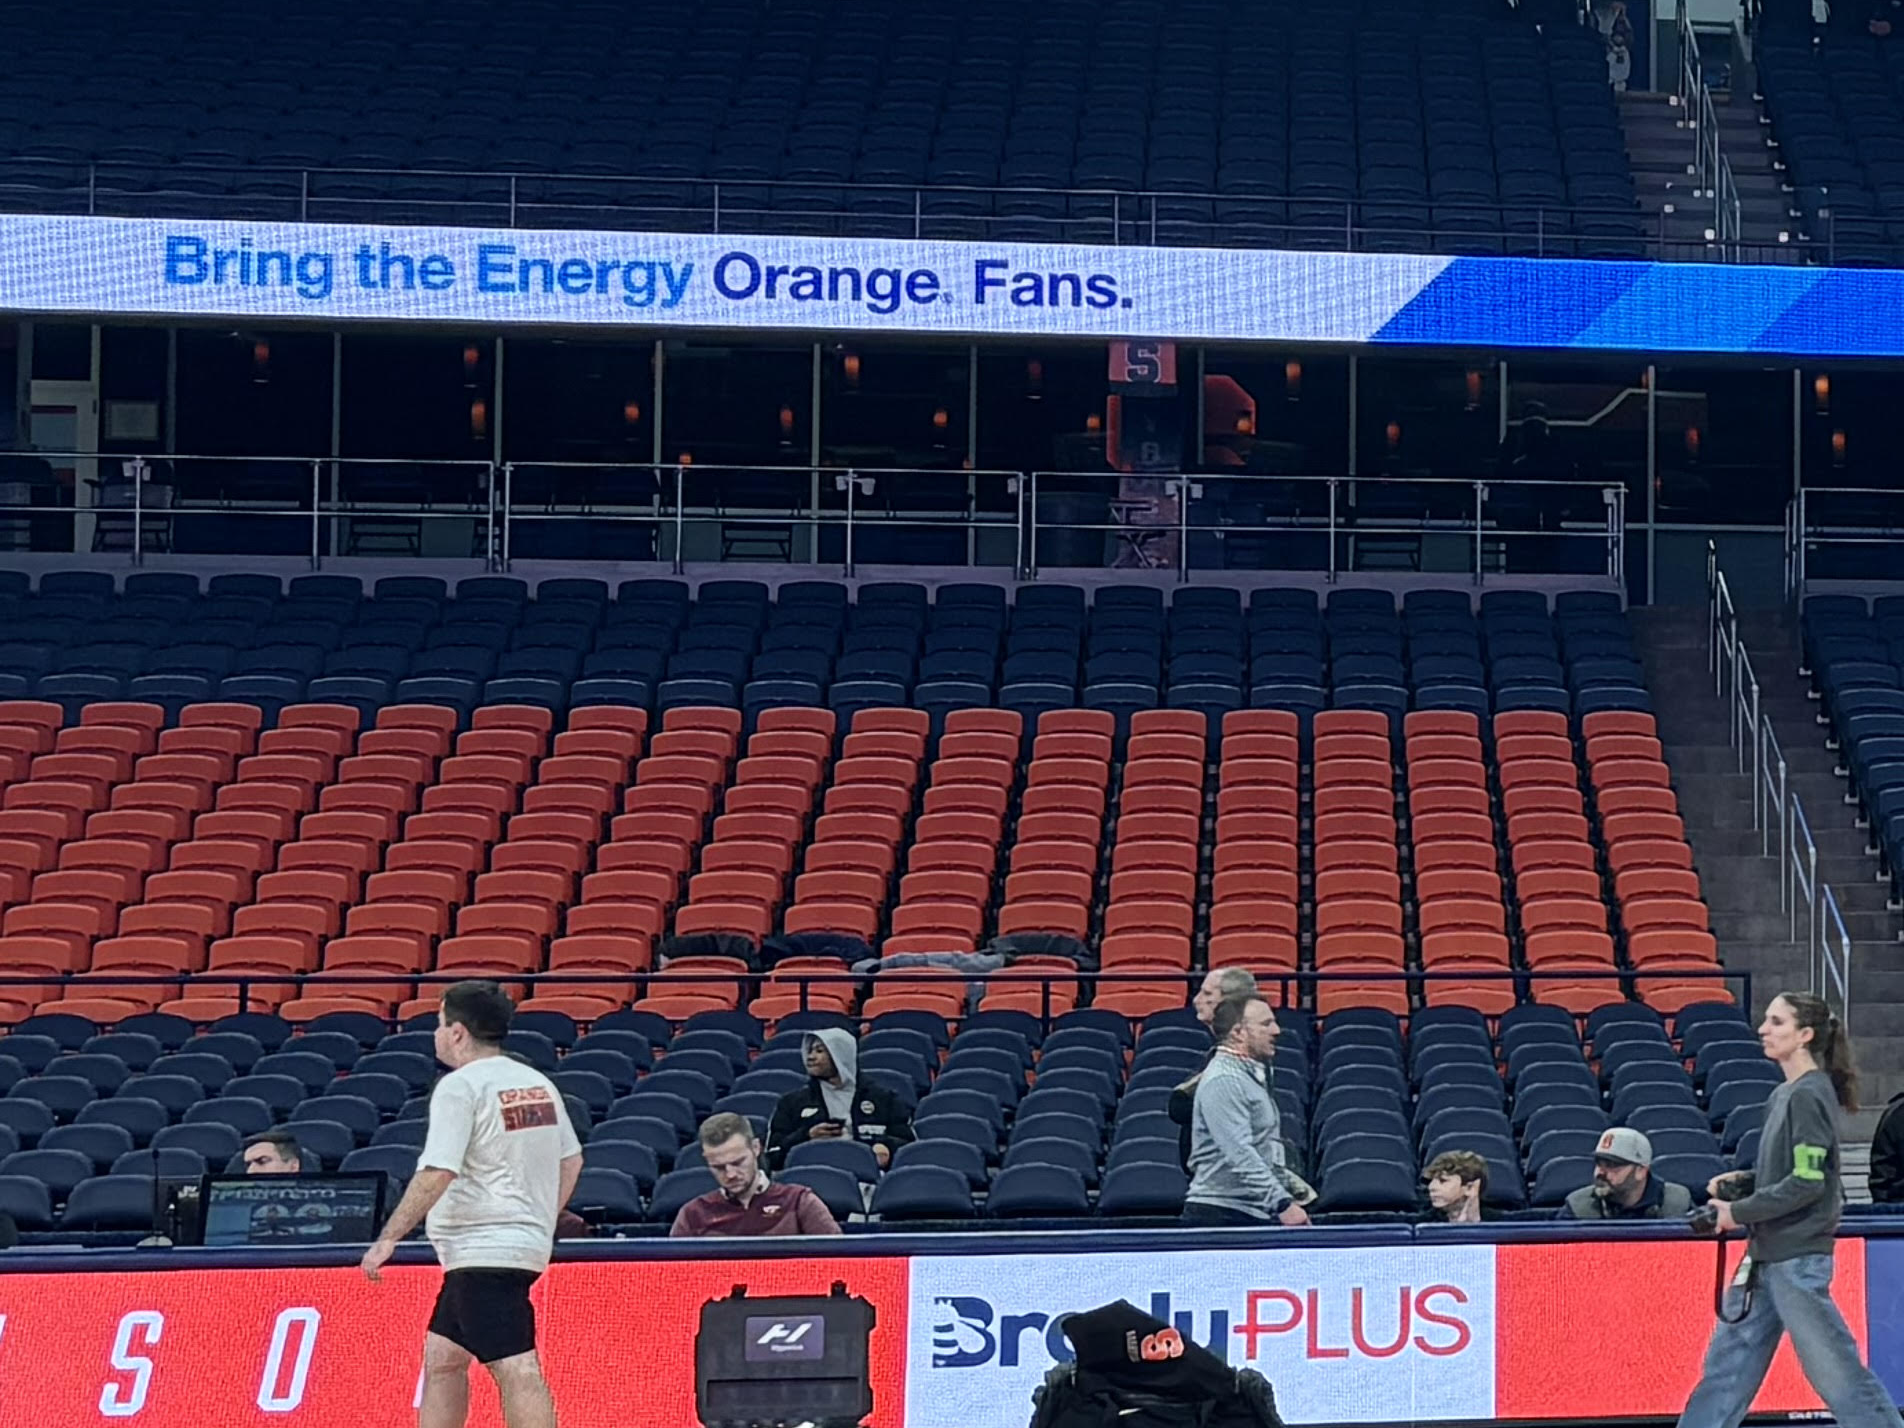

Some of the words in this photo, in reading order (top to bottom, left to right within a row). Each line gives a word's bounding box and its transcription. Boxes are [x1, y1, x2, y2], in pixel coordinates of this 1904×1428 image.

[163, 235, 334, 300] Bring
[354, 239, 456, 293] the
[477, 246, 695, 309] Energy
[974, 258, 1135, 312] Fans.
